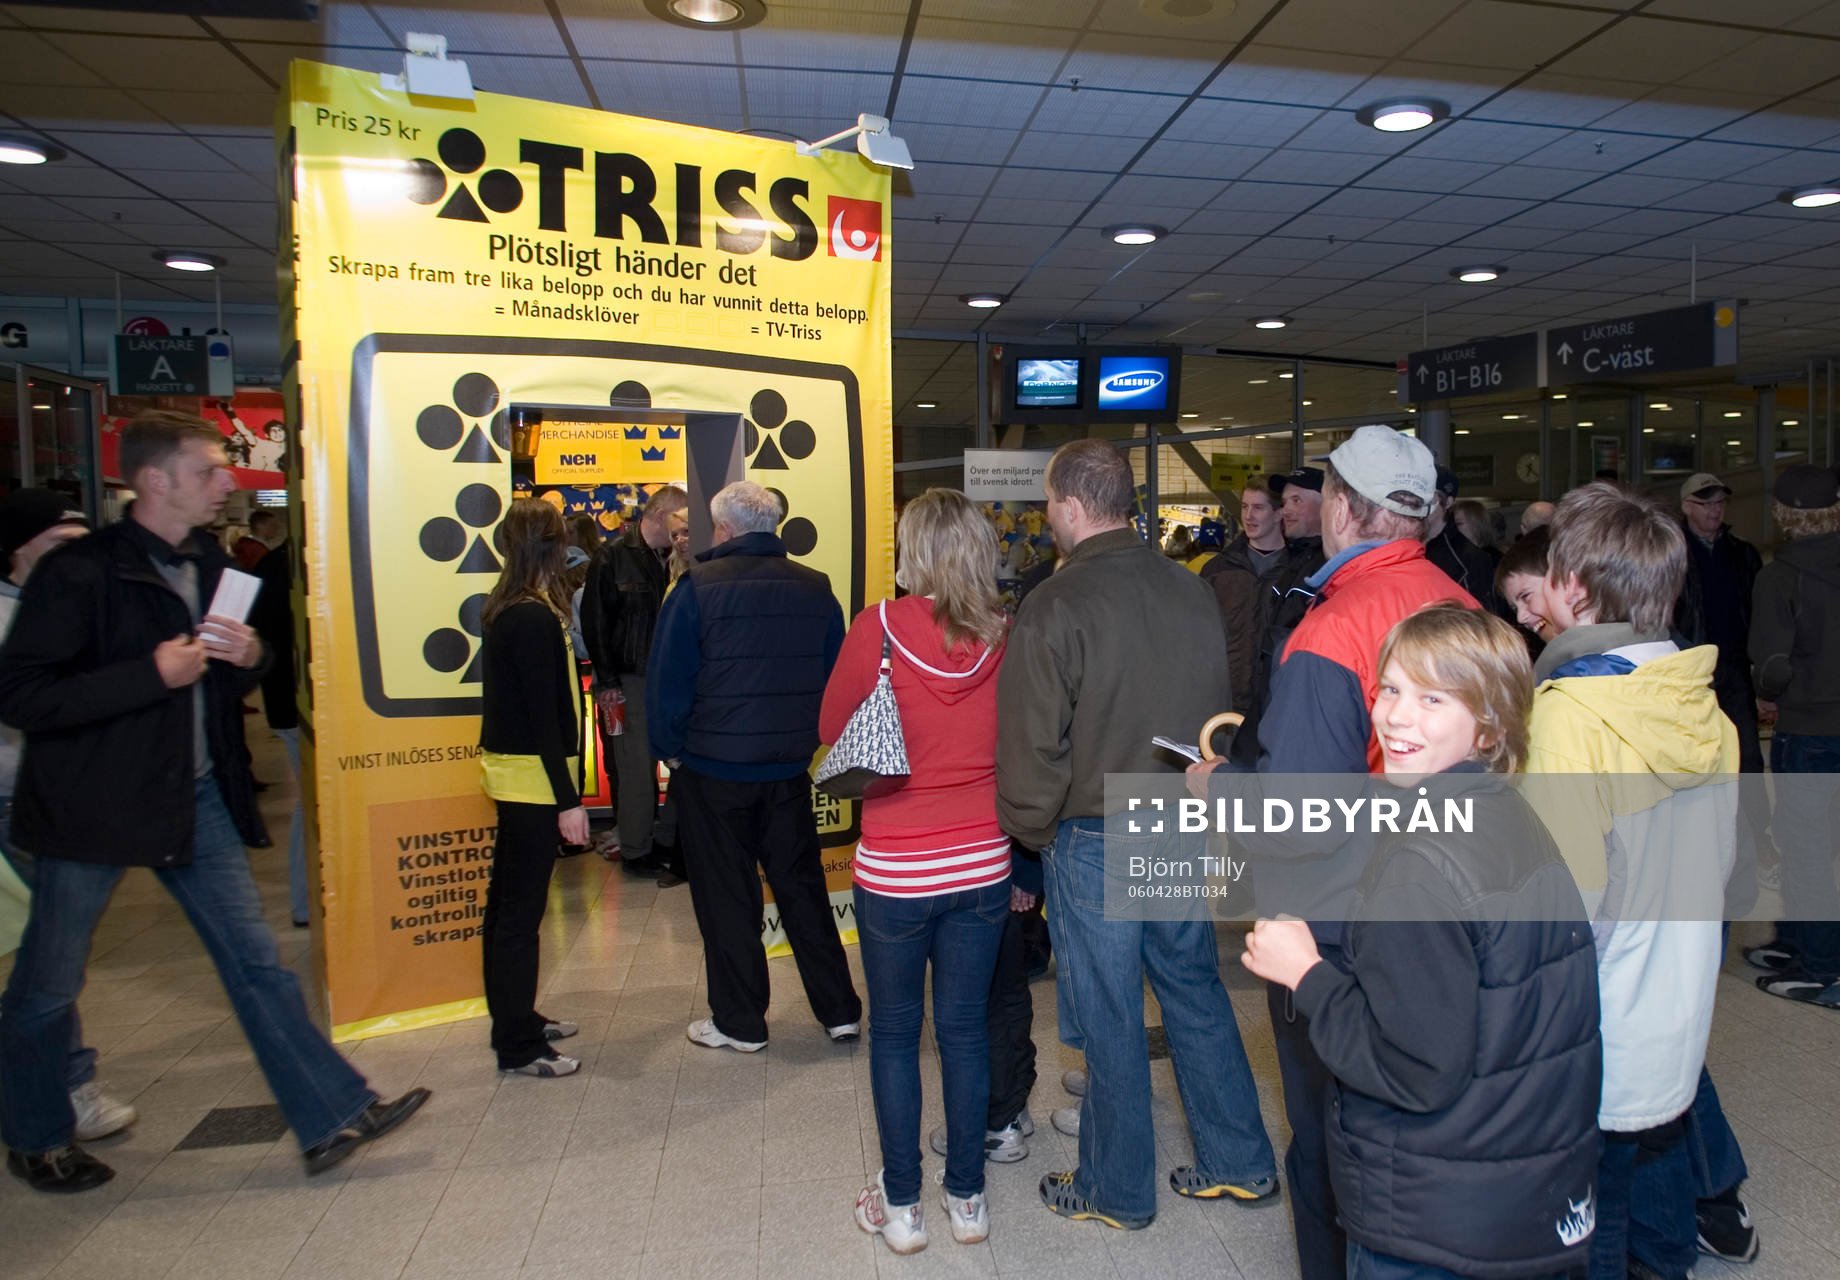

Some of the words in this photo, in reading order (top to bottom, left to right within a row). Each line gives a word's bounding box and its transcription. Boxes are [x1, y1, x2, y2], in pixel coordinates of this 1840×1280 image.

[315, 106, 358, 132] Pris
[364, 115, 392, 137] 25
[398, 120, 421, 142] kr
[519, 138, 818, 262] TRISS
[488, 234, 602, 277] Plötsligt
[615, 246, 707, 282] händer
[718, 258, 758, 287] det
[328, 254, 399, 282] Skrapa
[408, 262, 455, 285] fram
[464, 268, 491, 288] tre
[500, 270, 534, 291] lika
[542, 275, 604, 301] belopp
[612, 280, 643, 301] och
[651, 283, 672, 304] du
[679, 286, 706, 307] har
[713, 292, 763, 313] vunnit
[769, 295, 810, 318] detta
[815, 299, 869, 324] belopp.
[512, 298, 640, 325] Månadsklöver
[765, 321, 822, 341] TV-Triss
[150, 355, 176, 380] A
[1583, 343, 1655, 373] C-väst
[1112, 378, 1156, 387] SAMSUNG
[969, 465, 990, 475] Över
[991, 467, 1001, 475] en
[1003, 466, 1030, 476] miljard
[970, 478, 981, 486] till
[982, 478, 1009, 486] svensk
[338, 752, 382, 771] VINST
[387, 746, 444, 767] INLÖSES
[408, 887, 477, 909] ogiltig
